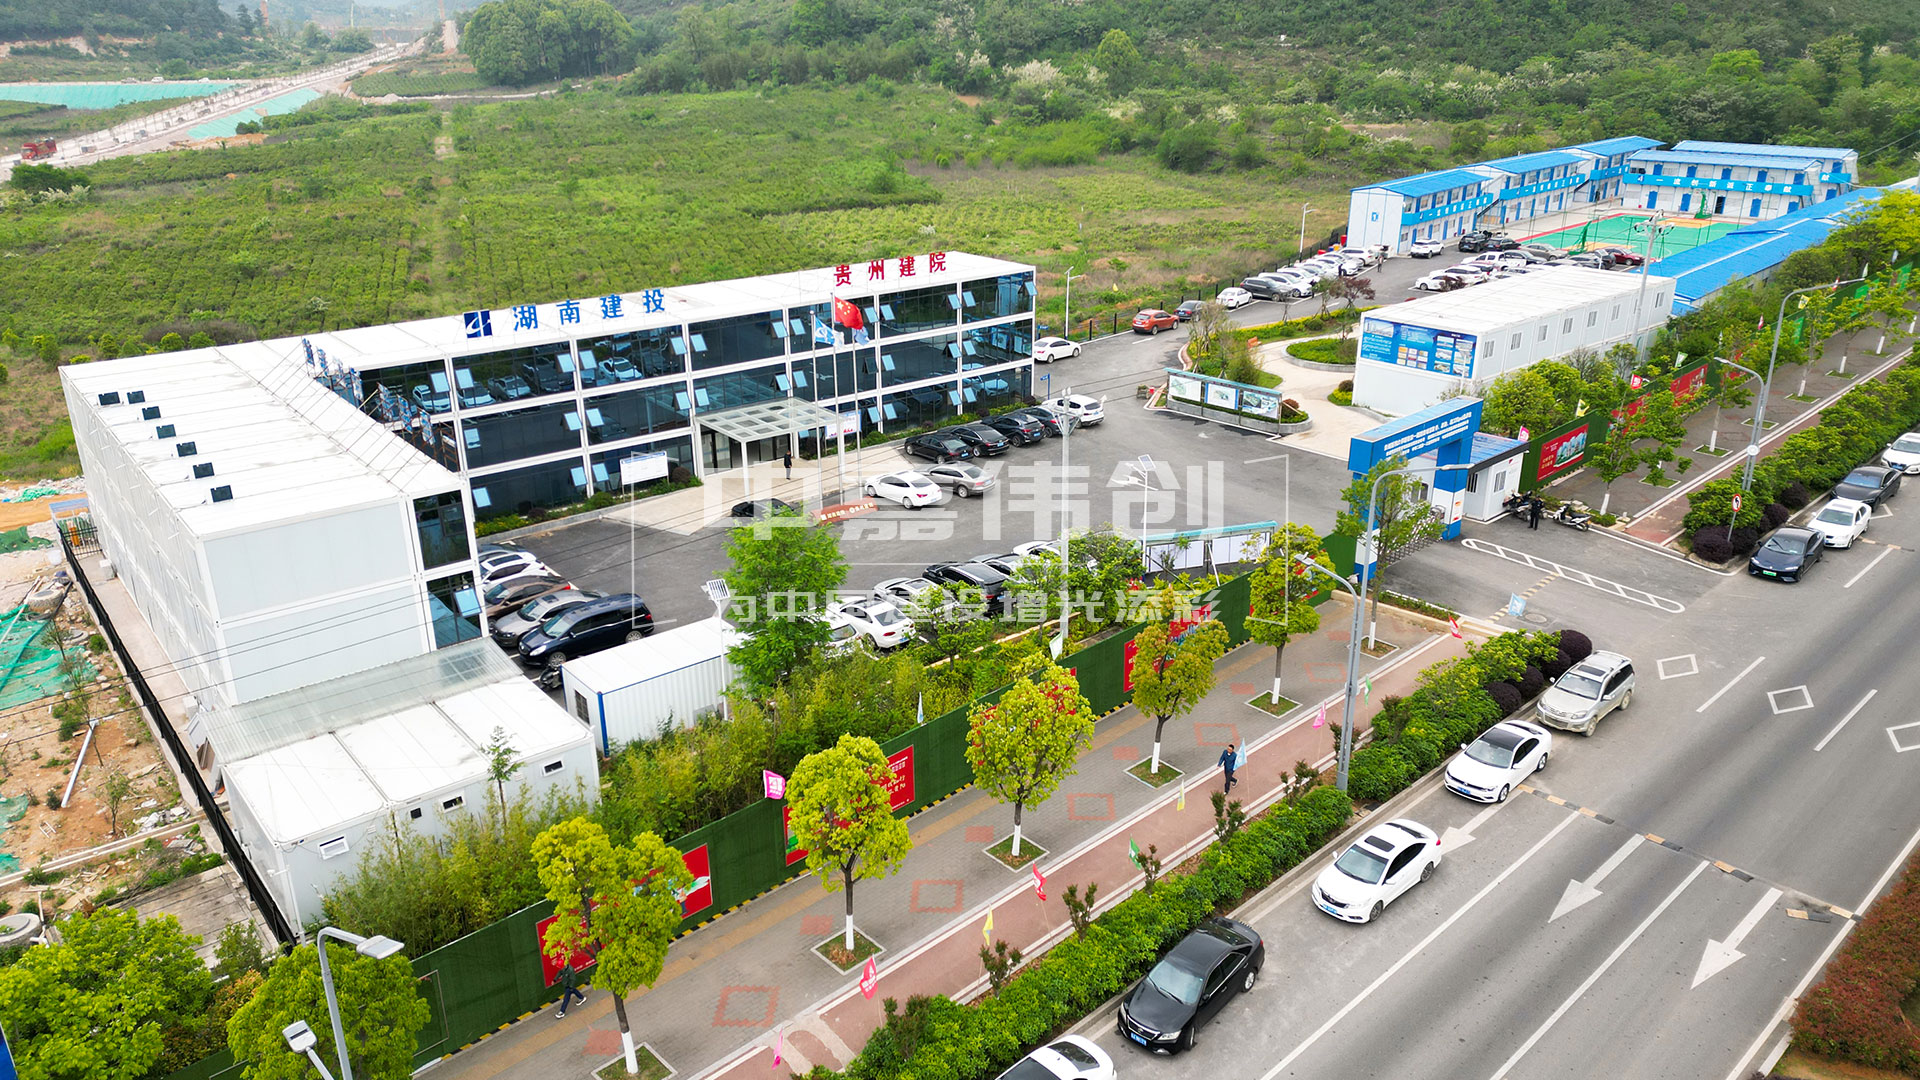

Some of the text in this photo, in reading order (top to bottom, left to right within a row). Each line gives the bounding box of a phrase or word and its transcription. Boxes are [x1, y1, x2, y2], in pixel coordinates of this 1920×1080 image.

[834, 251, 946, 287] 贵州建院
[513, 289, 665, 331] 湖南建投
